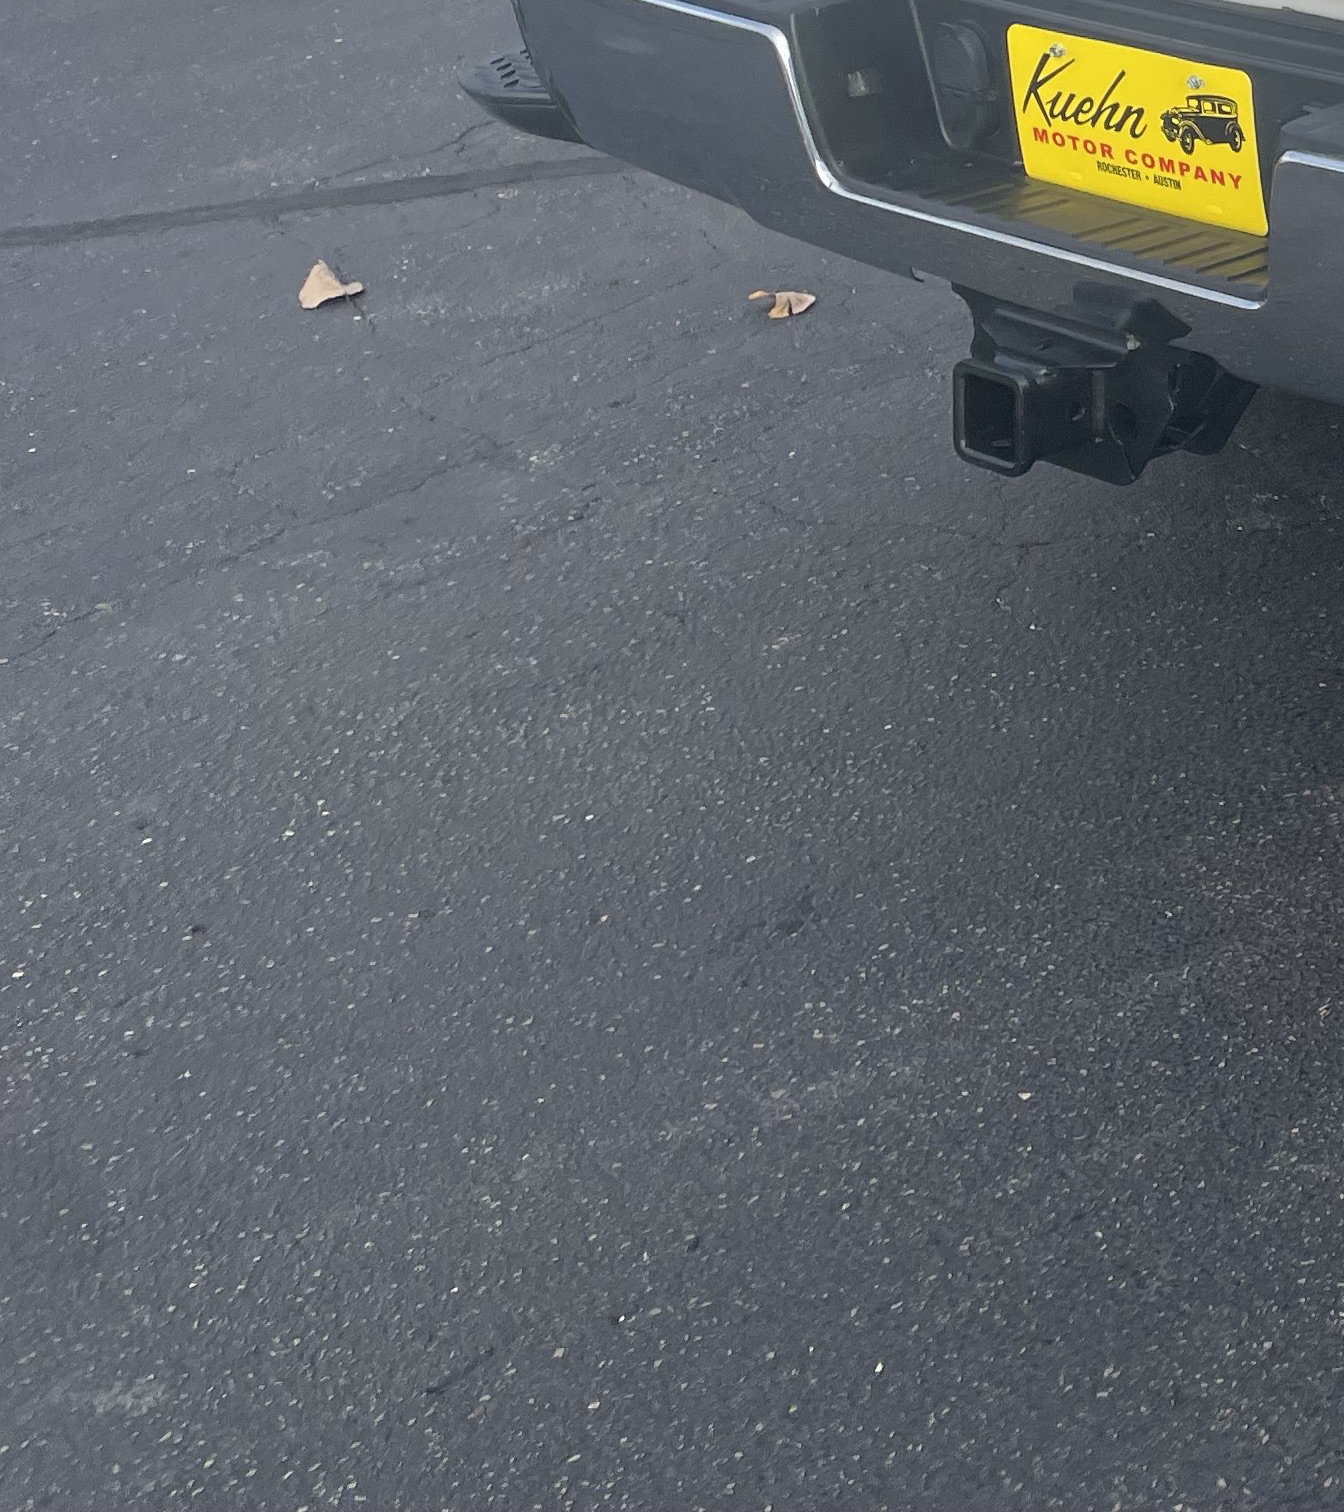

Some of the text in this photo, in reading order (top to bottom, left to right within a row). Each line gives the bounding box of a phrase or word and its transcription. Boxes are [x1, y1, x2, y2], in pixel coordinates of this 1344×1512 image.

[1022, 51, 1148, 140] Kuehn
[1032, 126, 1243, 190] MOTOR COMPANY
[1096, 160, 1183, 191] ROCHESTER AUSTIN
